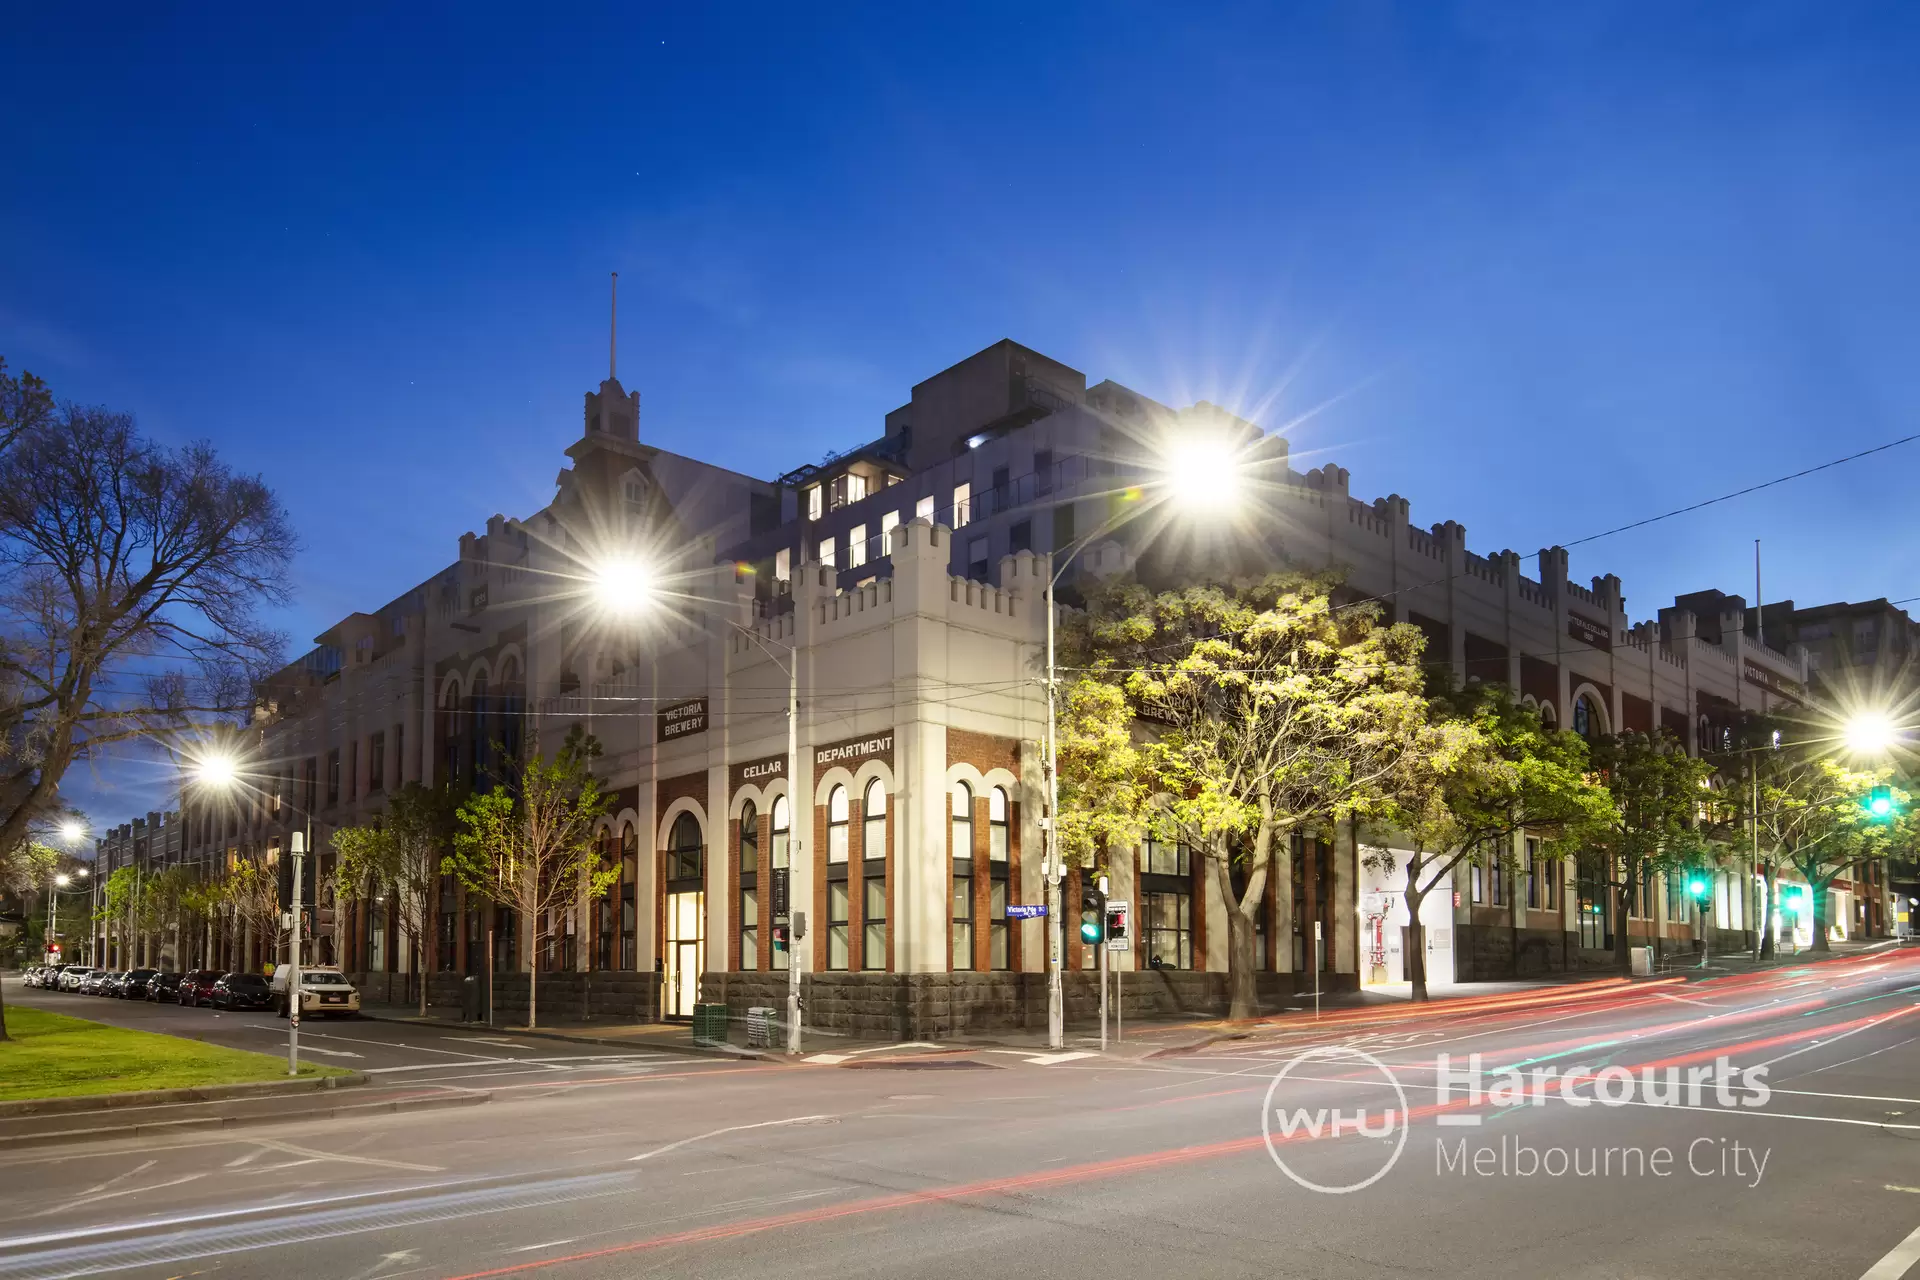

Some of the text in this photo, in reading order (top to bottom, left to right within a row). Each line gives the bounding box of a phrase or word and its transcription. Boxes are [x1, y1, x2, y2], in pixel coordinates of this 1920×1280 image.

[1744, 664, 1768, 685] VICTORIA
[665, 702, 703, 721] VICTORIA
[664, 716, 704, 736] BREWERY
[743, 736, 893, 778] CELLAR DEPARTMENT
[1007, 905, 1027, 914] Victoria
